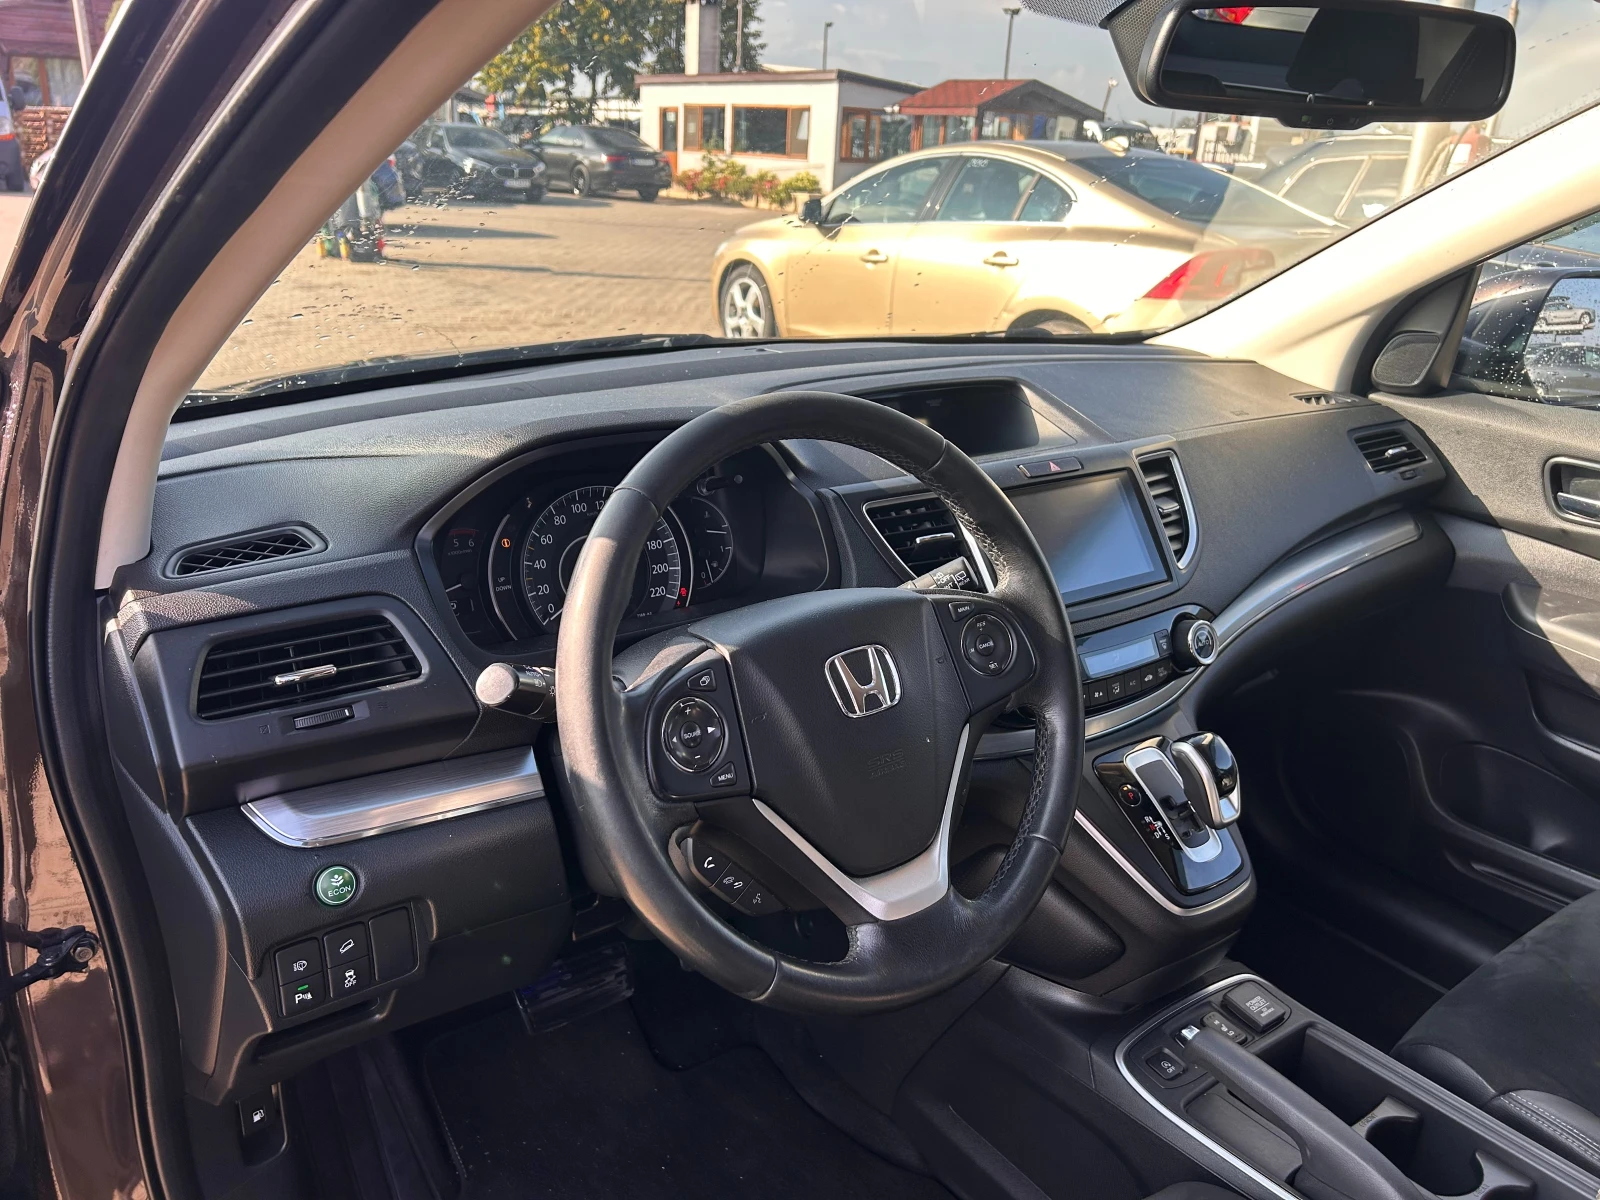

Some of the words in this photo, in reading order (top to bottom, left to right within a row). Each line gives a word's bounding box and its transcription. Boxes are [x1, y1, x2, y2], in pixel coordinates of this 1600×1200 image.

[571, 502, 587, 513] 100
[595, 500, 605, 510] 12
[554, 514, 567, 525] 80
[453, 539, 459, 547] 5
[468, 539, 475, 547] 6
[540, 534, 553, 545] 60
[647, 539, 663, 550] 180
[533, 559, 547, 570] 40
[651, 563, 669, 574] 200
[495, 584, 512, 592] DOWN
[537, 584, 550, 595] 20
[650, 586, 666, 597] 220
[547, 603, 555, 613] 0
[957, 605, 970, 613] MAIN
[717, 772, 734, 782] MENU
[327, 885, 351, 898] ECON
[344, 980, 357, 988] OFF
